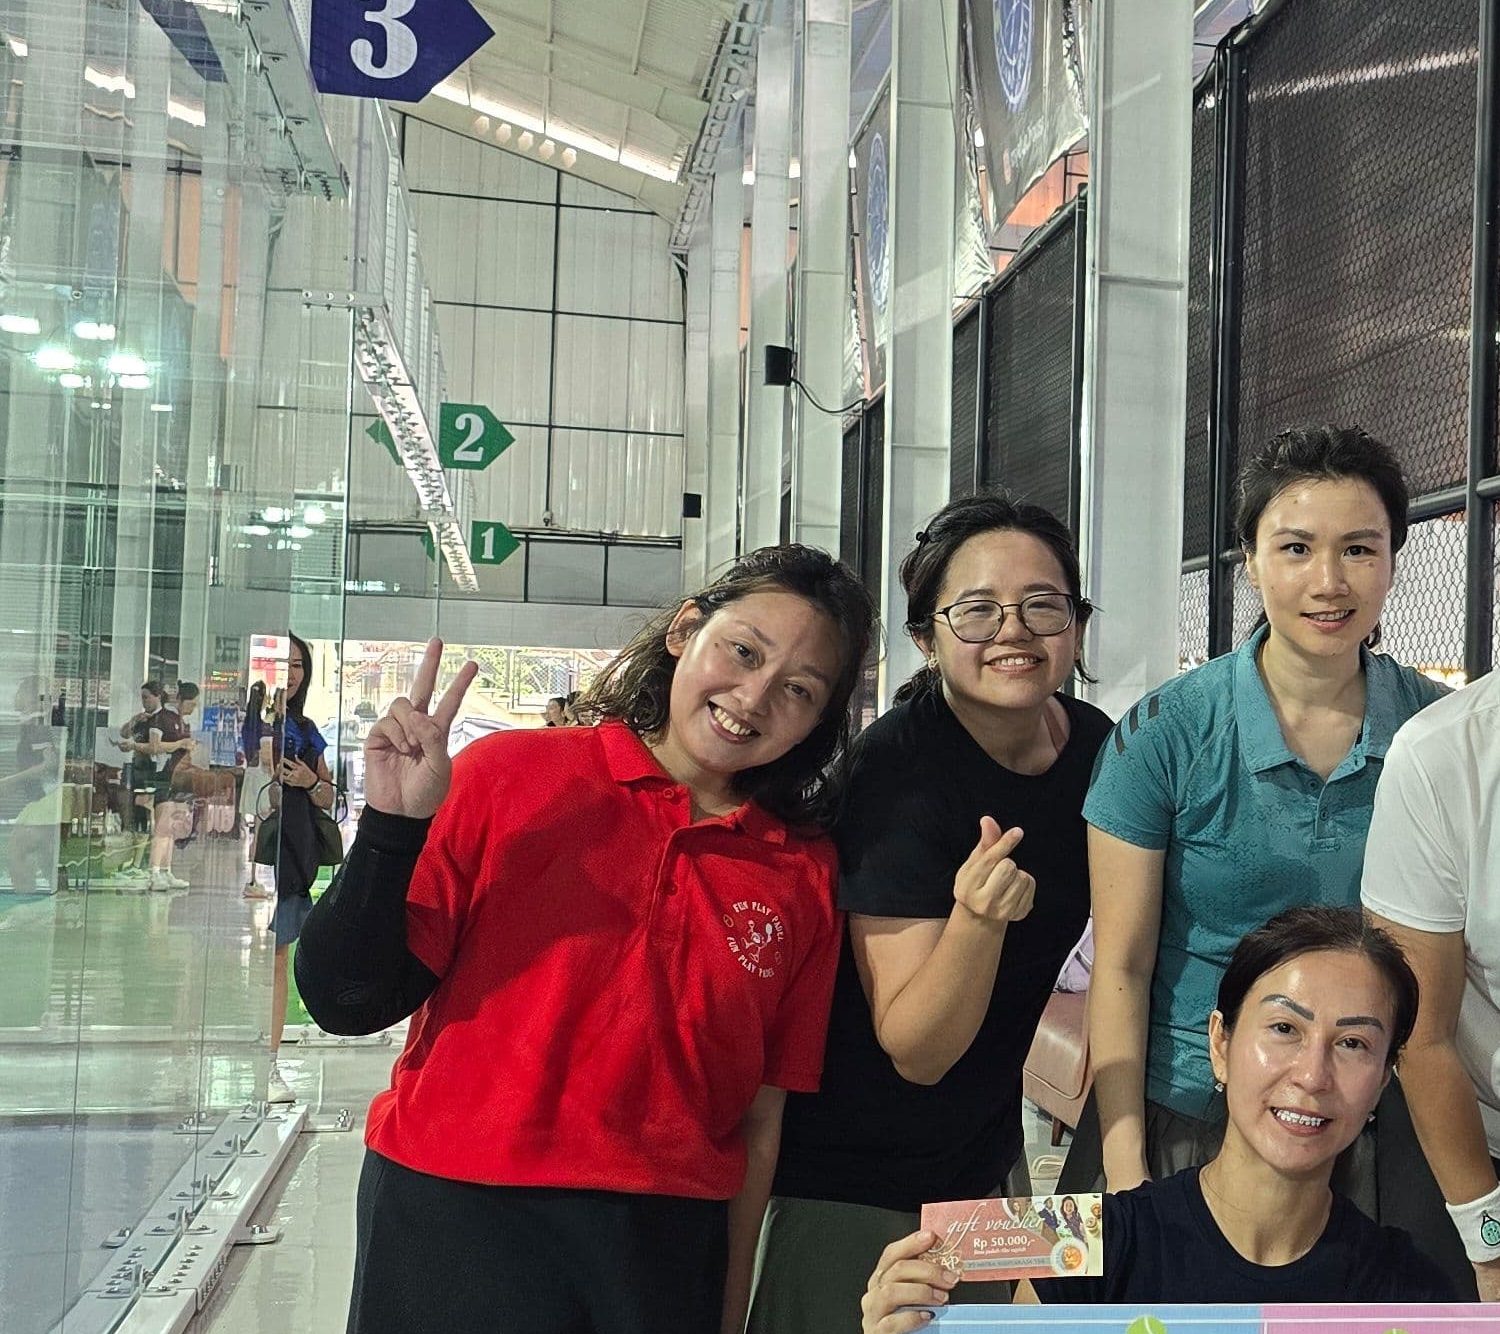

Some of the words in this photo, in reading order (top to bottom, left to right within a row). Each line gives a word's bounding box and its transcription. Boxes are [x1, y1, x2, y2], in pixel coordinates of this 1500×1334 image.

[453, 412, 485, 463] 2
[481, 527, 495, 560] 1
[973, 1238, 987, 1250] Rp
